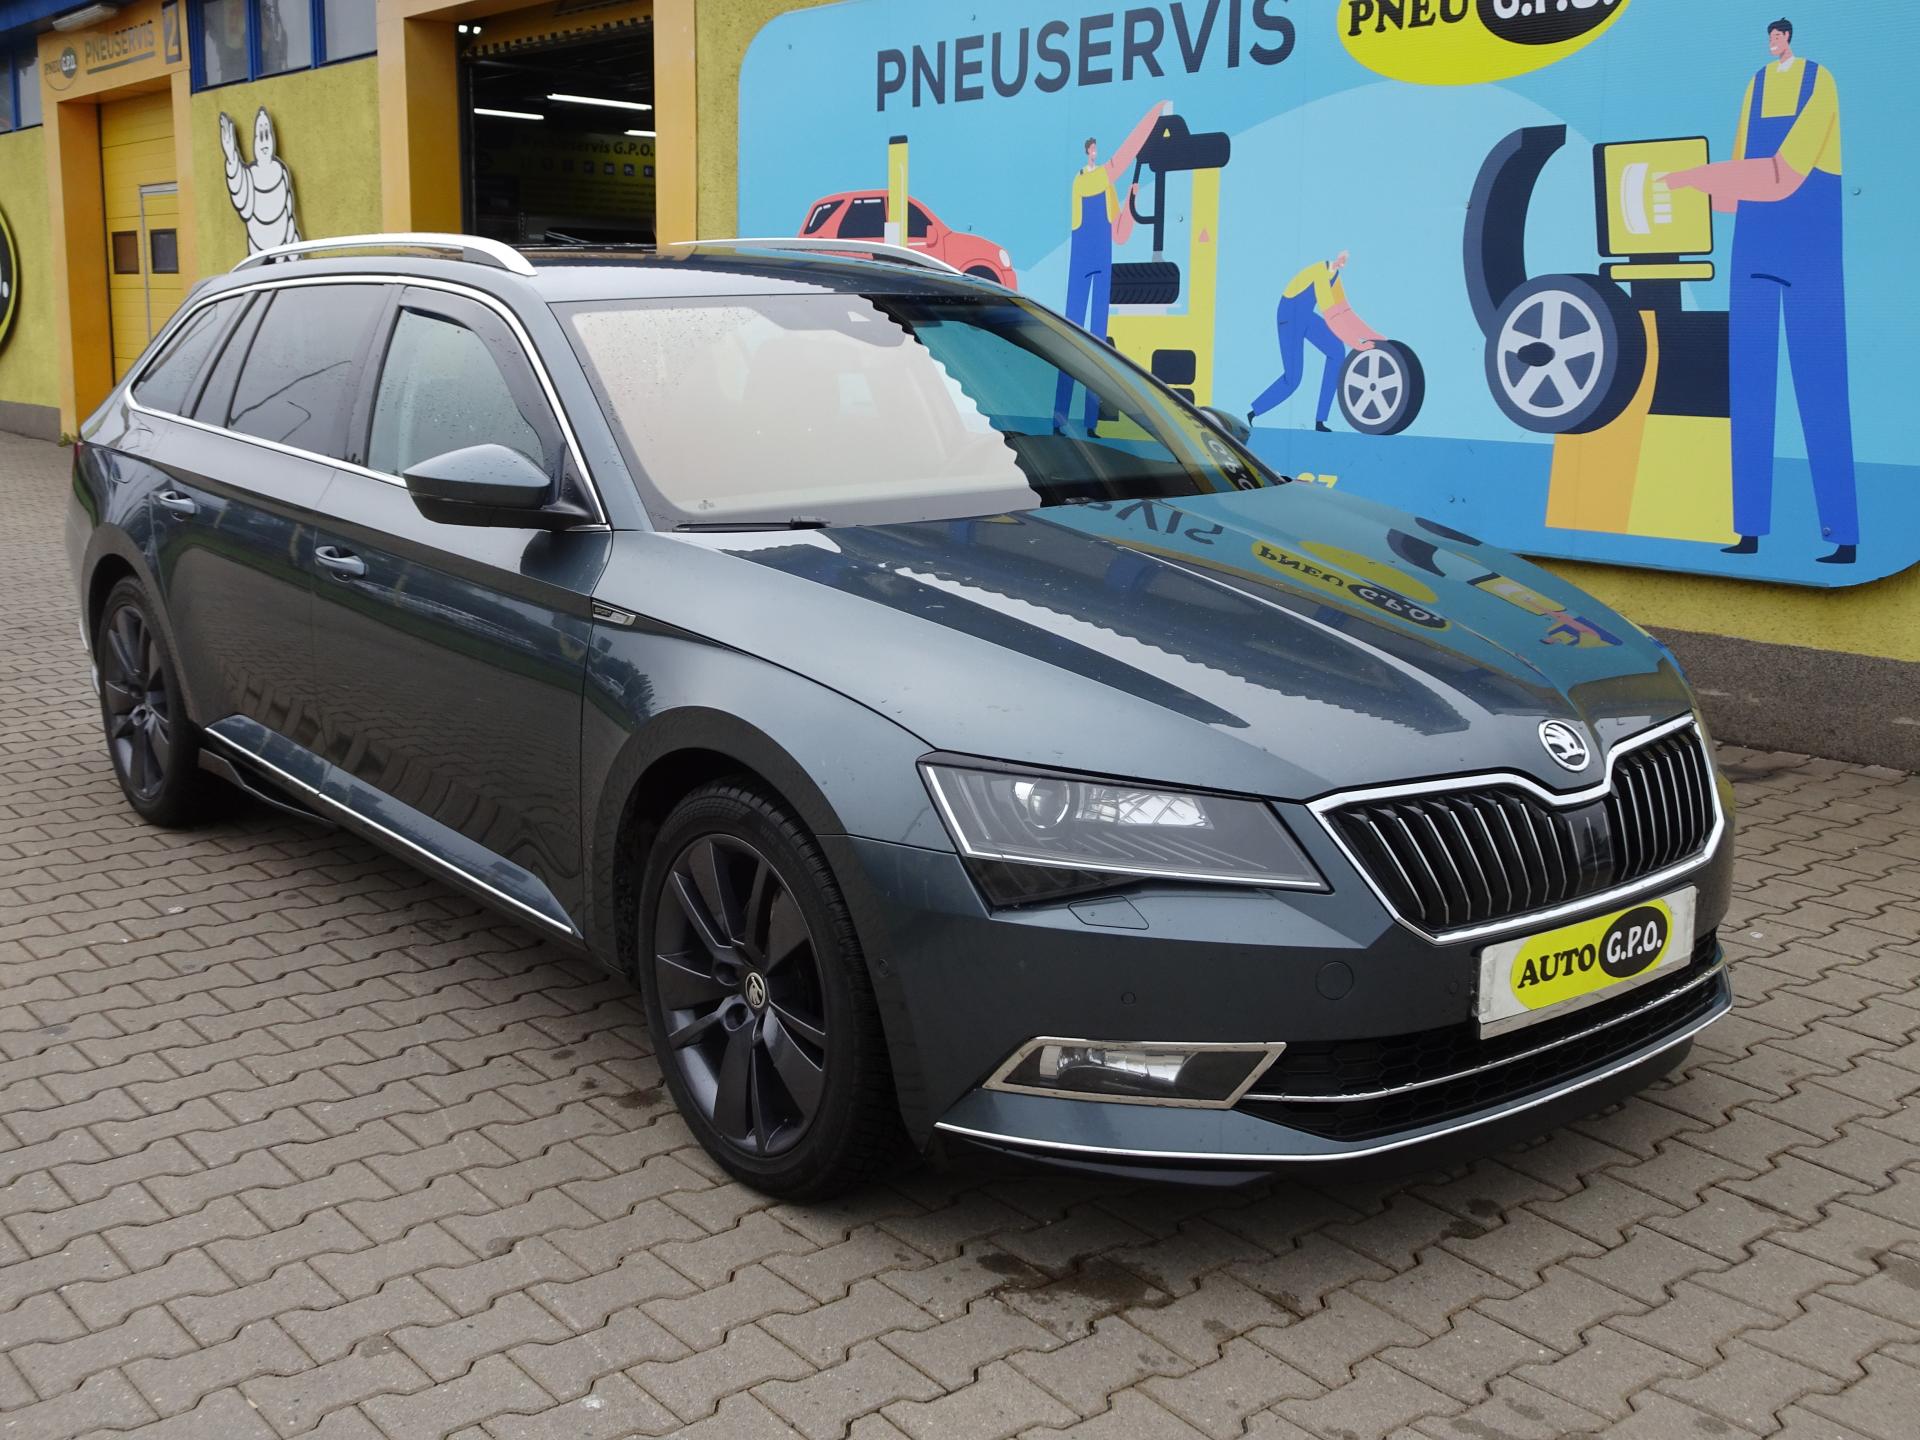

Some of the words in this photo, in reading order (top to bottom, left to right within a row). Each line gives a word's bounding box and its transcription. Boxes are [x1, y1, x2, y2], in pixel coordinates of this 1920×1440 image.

[85, 20, 155, 65] PNEUSERVIS
[1348, 0, 1469, 36] PNEU
[877, 0, 1296, 112] PNEUSERVIS
[1517, 943, 1597, 989] AUTO
[1606, 920, 1663, 963] G.P.O.
